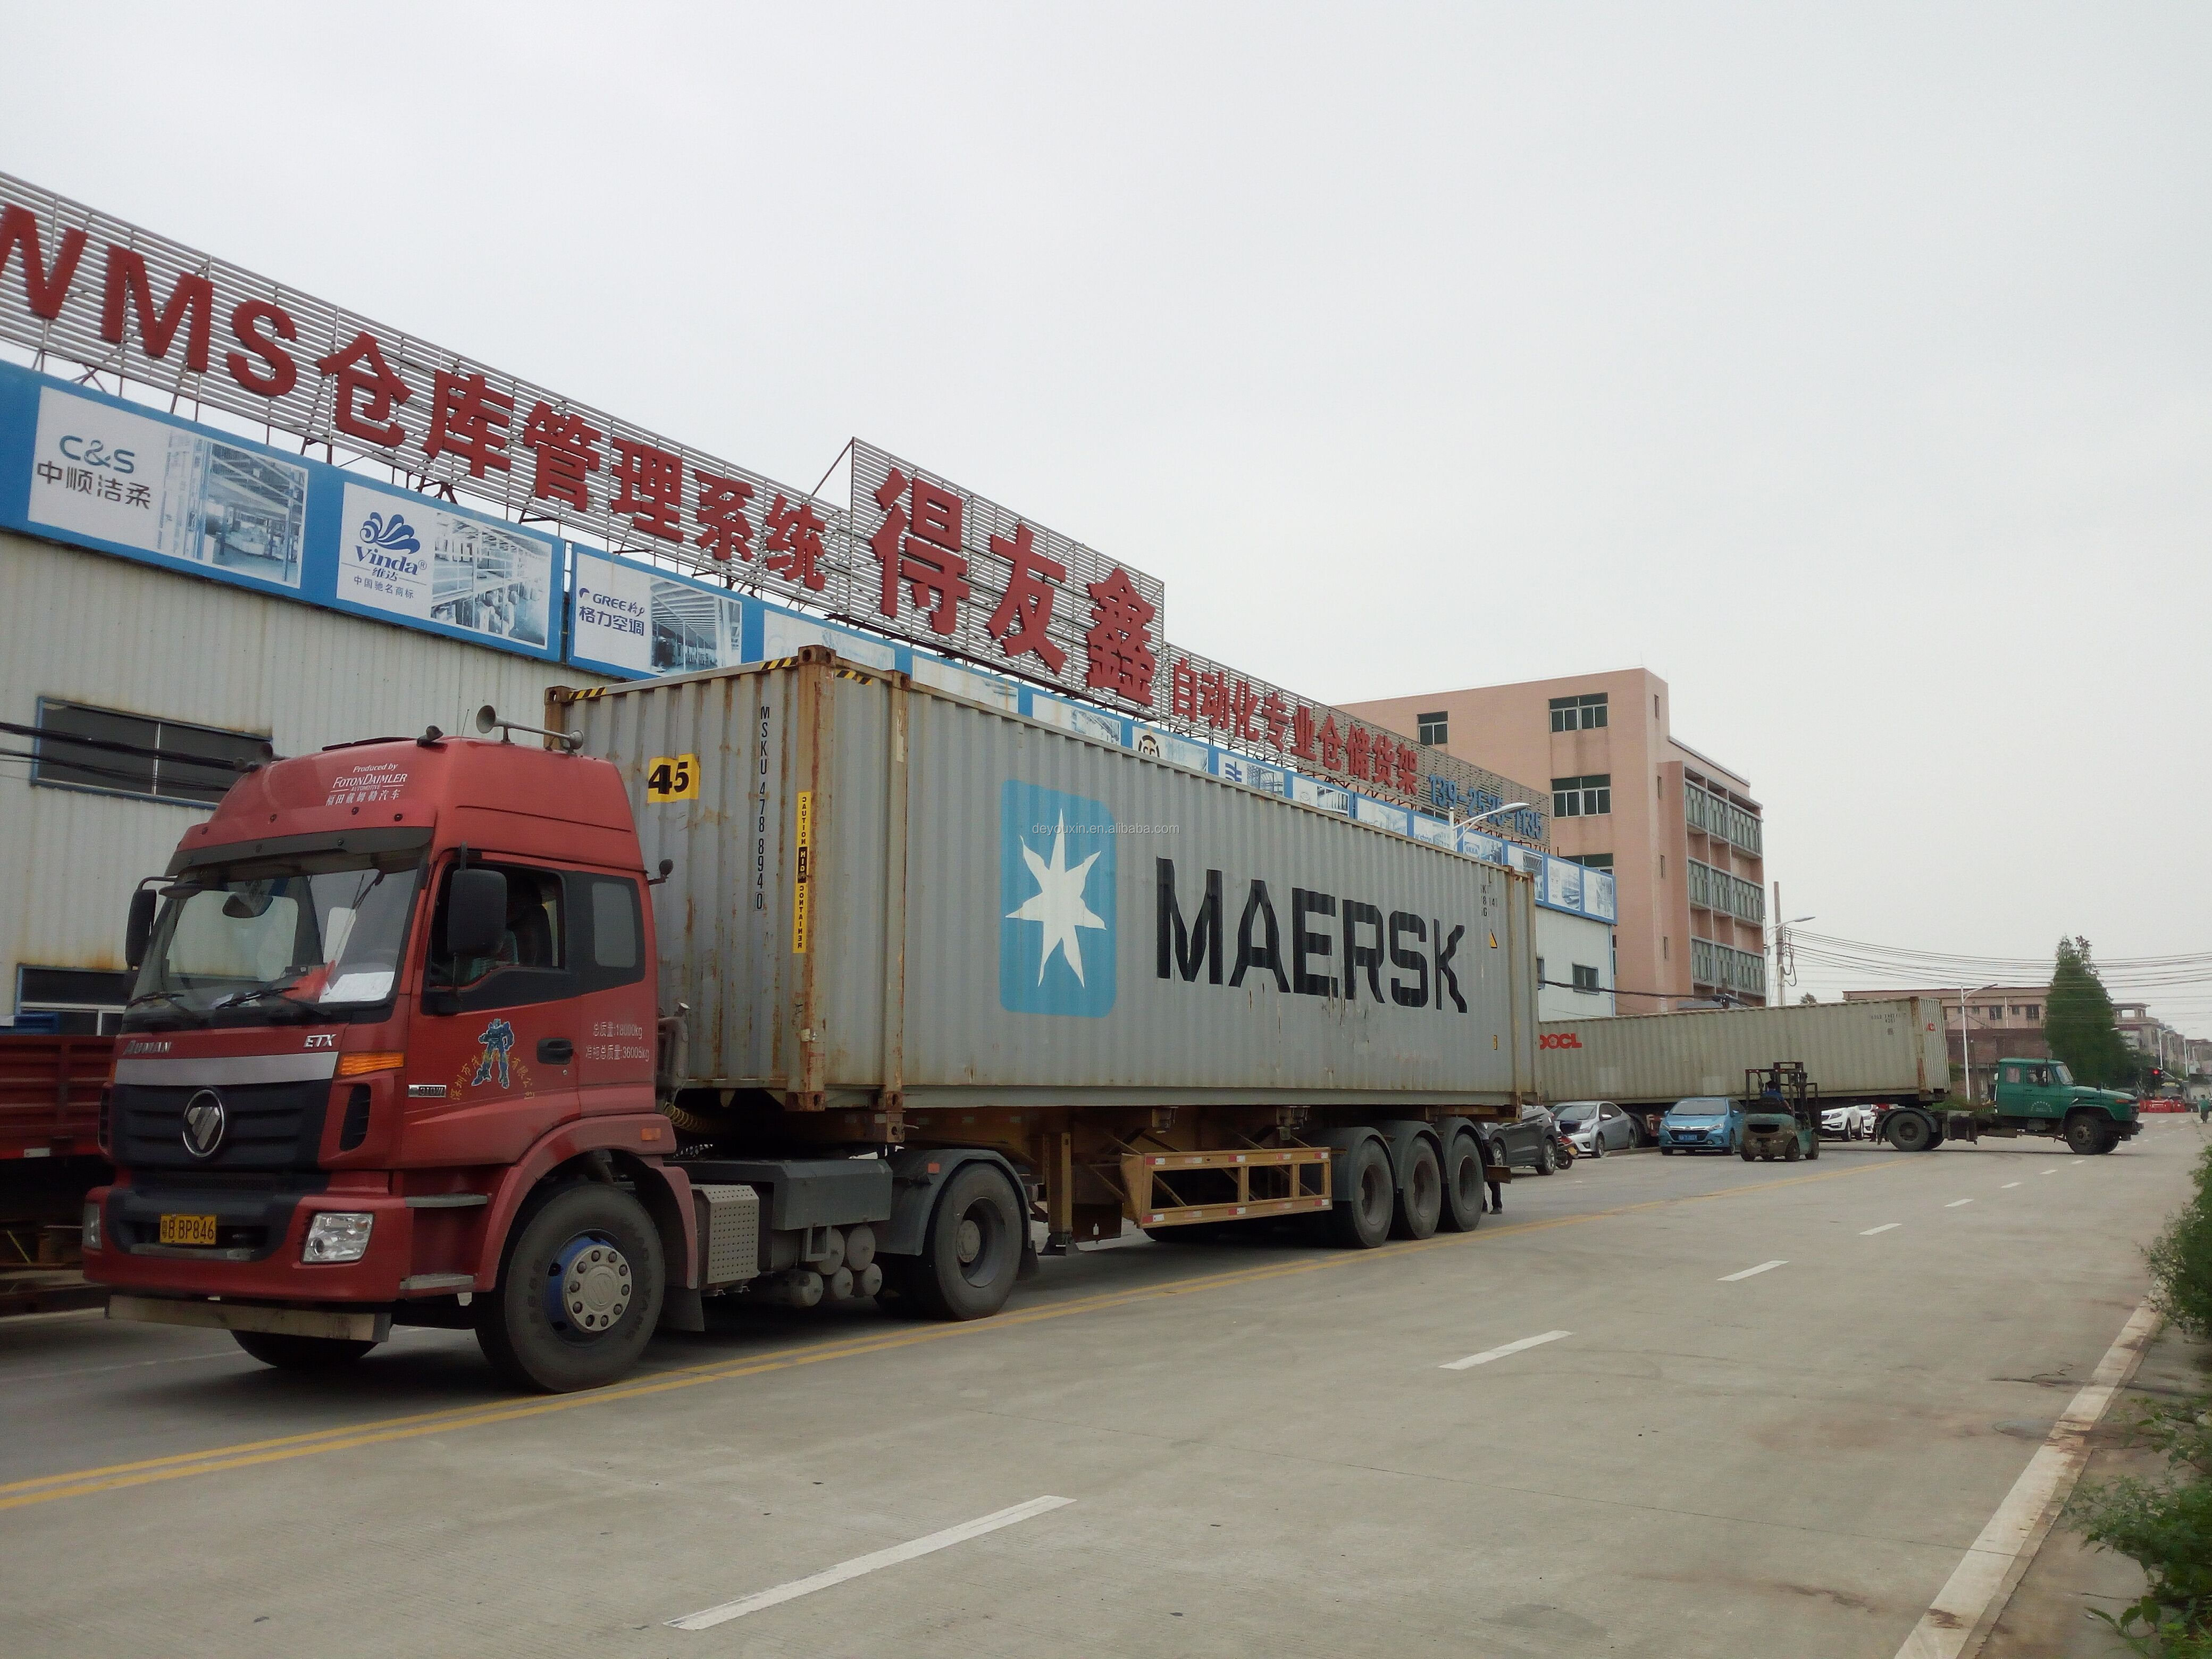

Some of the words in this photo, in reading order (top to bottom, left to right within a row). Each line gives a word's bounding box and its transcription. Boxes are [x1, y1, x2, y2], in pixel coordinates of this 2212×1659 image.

[59, 435, 135, 474] C&S
[37, 460, 150, 509] 中顺洁柔
[354, 575, 414, 599] 中国驰名商标
[372, 567, 398, 581] 维达
[869, 467, 1156, 706] 得友鑫
[579, 606, 644, 636] 格力空调
[760, 706, 770, 775] MSKU
[1173, 657, 1418, 795] 自动化专业仓储货架
[353, 764, 387, 773] Produced
[648, 761, 690, 795] 45
[325, 789, 401, 806] 福田戴姆勒汽车
[1156, 856, 1468, 1013] MAERSK
[123, 1040, 172, 1055] AUMAN
[303, 1034, 337, 1049] ETX
